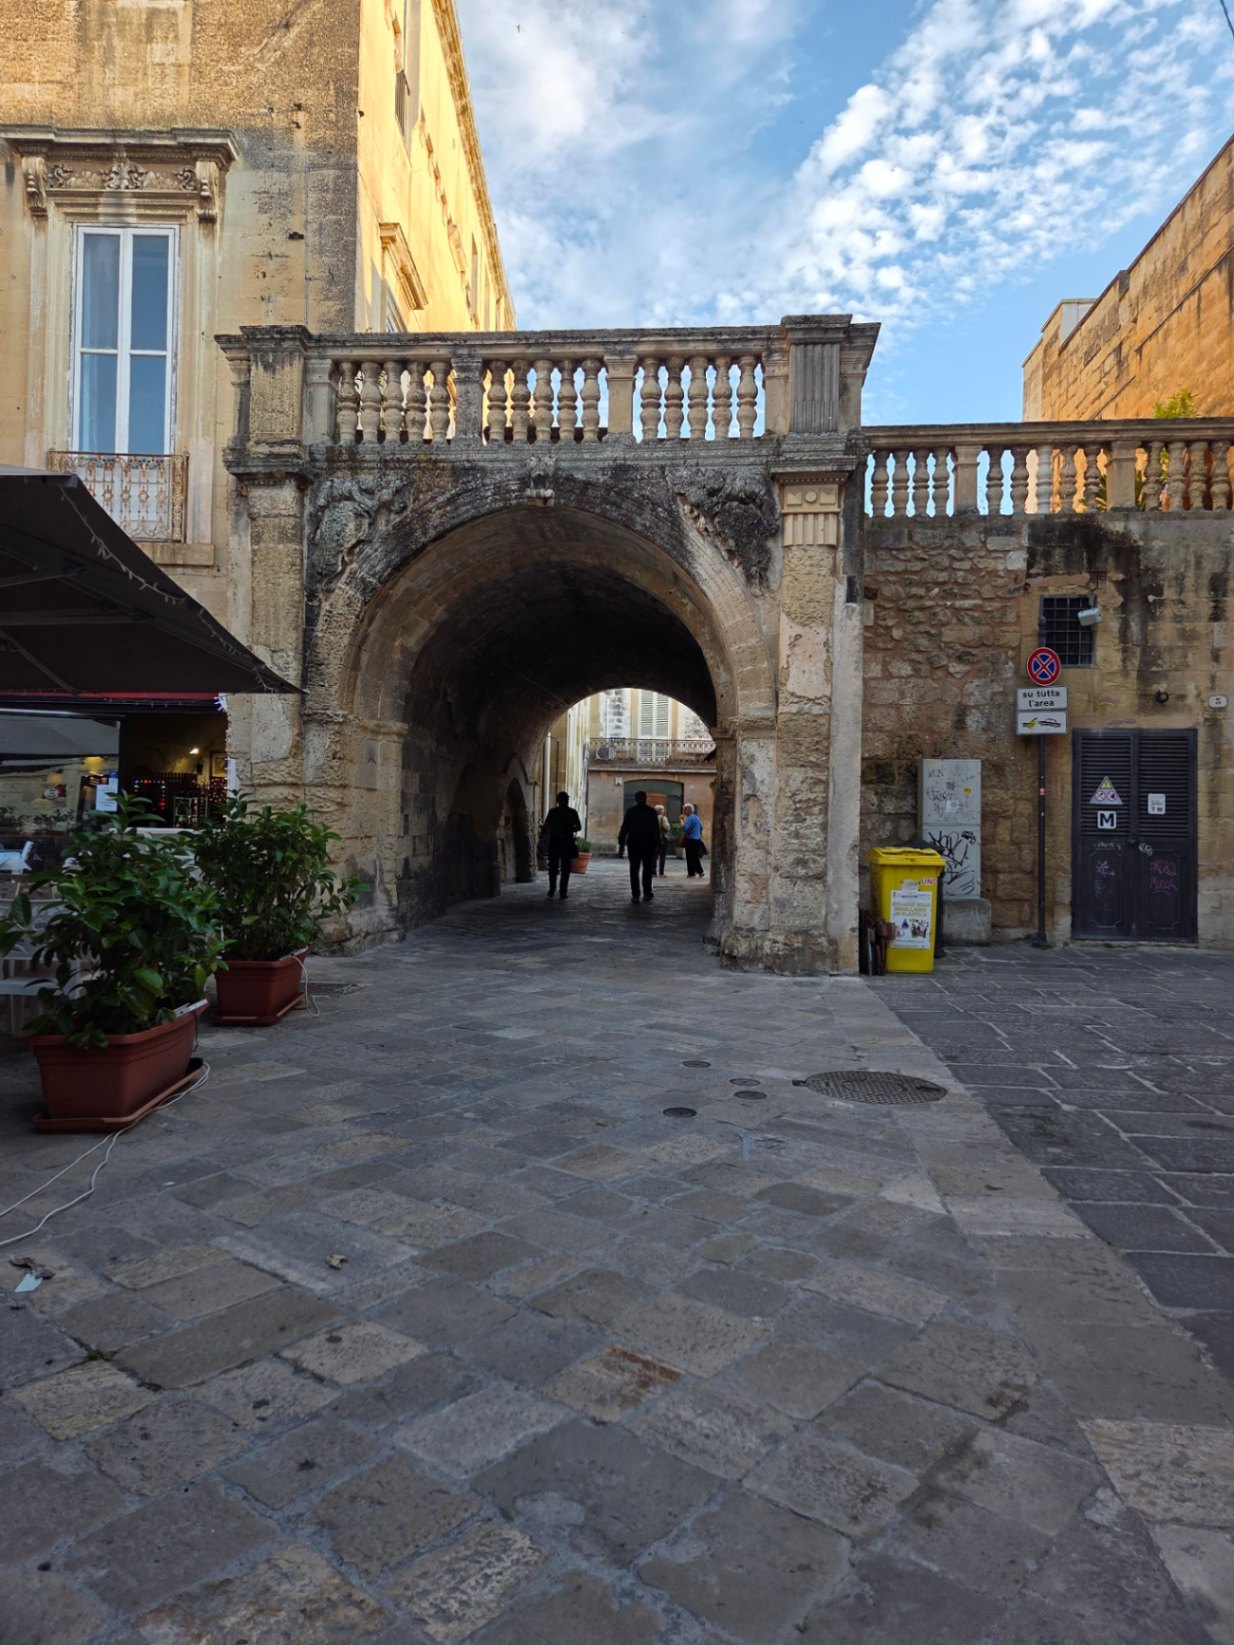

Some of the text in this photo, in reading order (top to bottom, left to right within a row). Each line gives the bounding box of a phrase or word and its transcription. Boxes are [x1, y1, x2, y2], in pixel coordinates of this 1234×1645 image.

[1036, 689, 1060, 698] tutta
[1028, 699, 1055, 707] l'area
[1099, 813, 1115, 827] M
